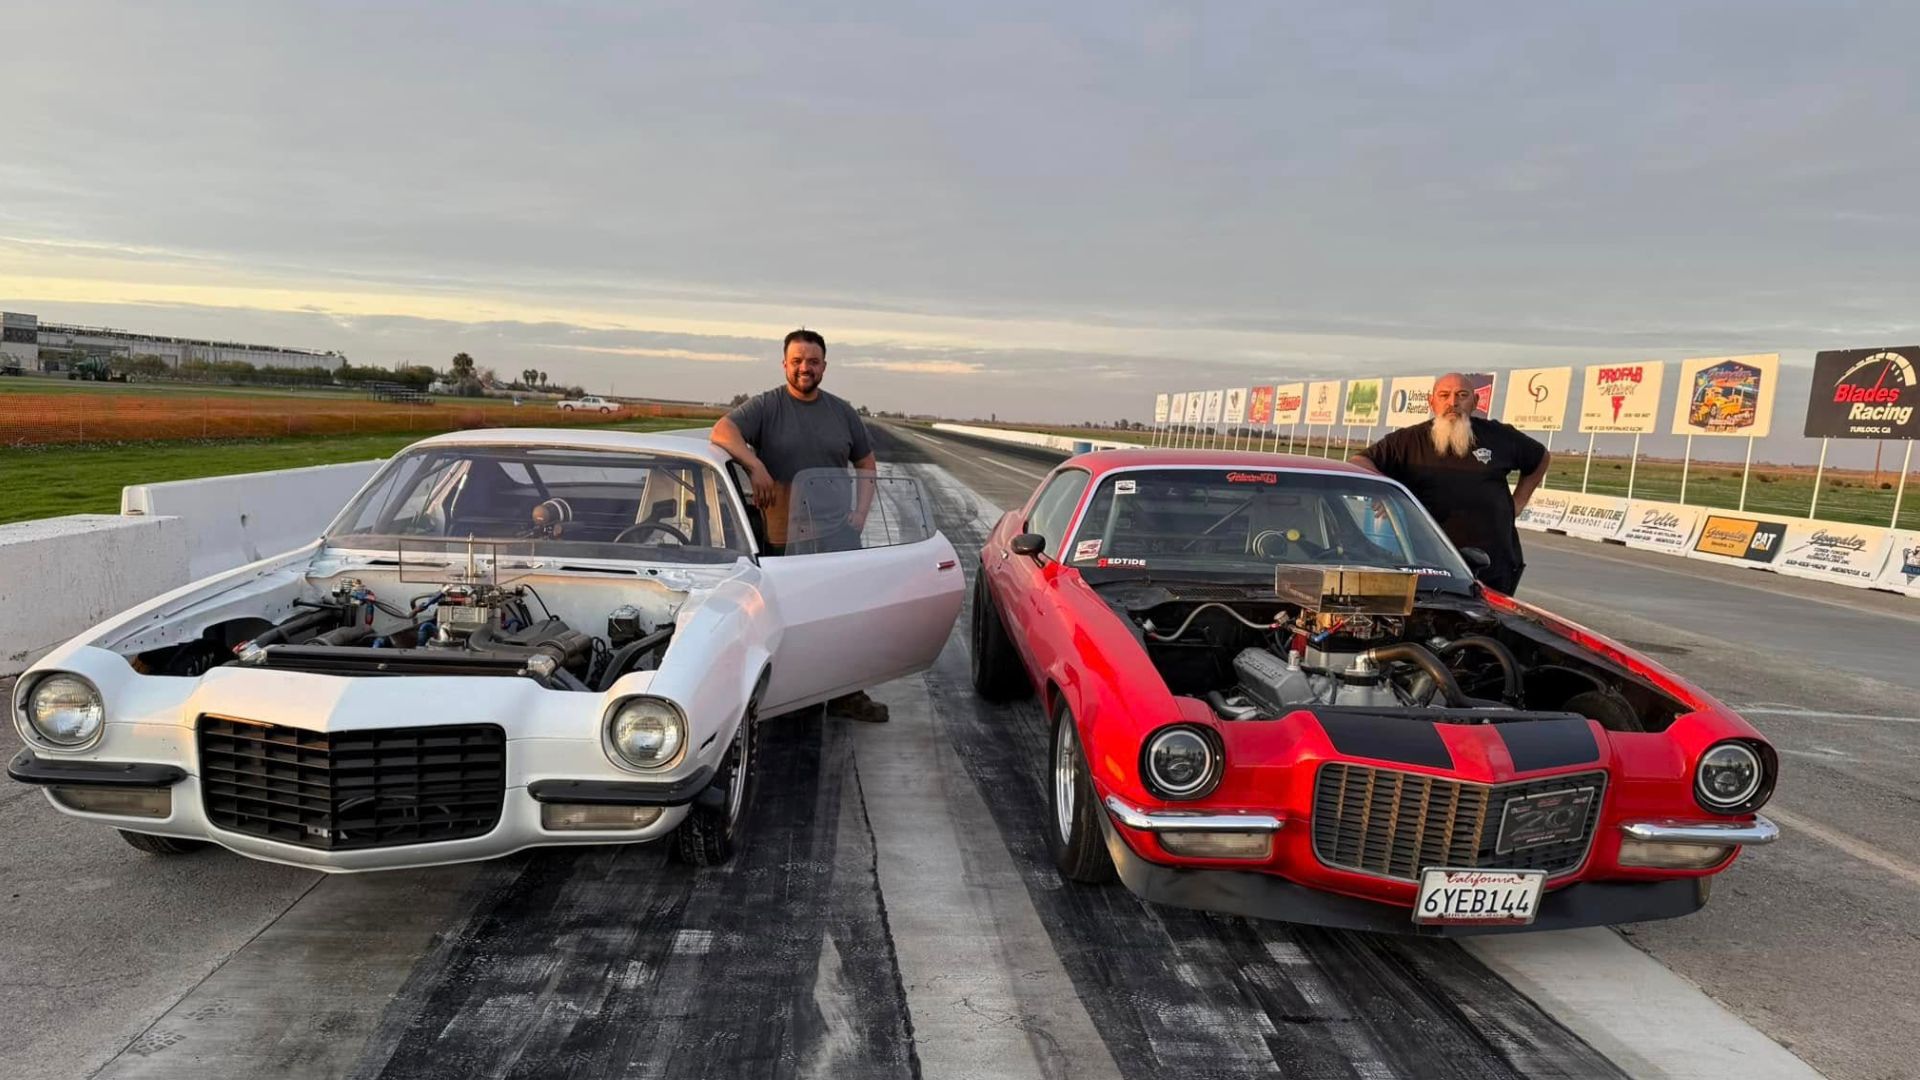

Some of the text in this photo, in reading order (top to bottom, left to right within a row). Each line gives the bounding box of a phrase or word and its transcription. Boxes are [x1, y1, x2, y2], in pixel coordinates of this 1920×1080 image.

[1597, 366, 1643, 385] PROFAB
[1408, 389, 1430, 401] United
[1833, 384, 1900, 403] Blades
[1406, 402, 1430, 414] Rentals
[1848, 402, 1914, 425] Racing
[1567, 516, 1617, 530] TRANSPORT LLC
[1589, 507, 1625, 520] FURNITURE
[1642, 509, 1680, 528] Delta
[1751, 532, 1777, 551] CAT
[1809, 529, 1867, 551] Gonzalez
[1446, 872, 1521, 886] California
[1424, 888, 1529, 914] 6YEB144
